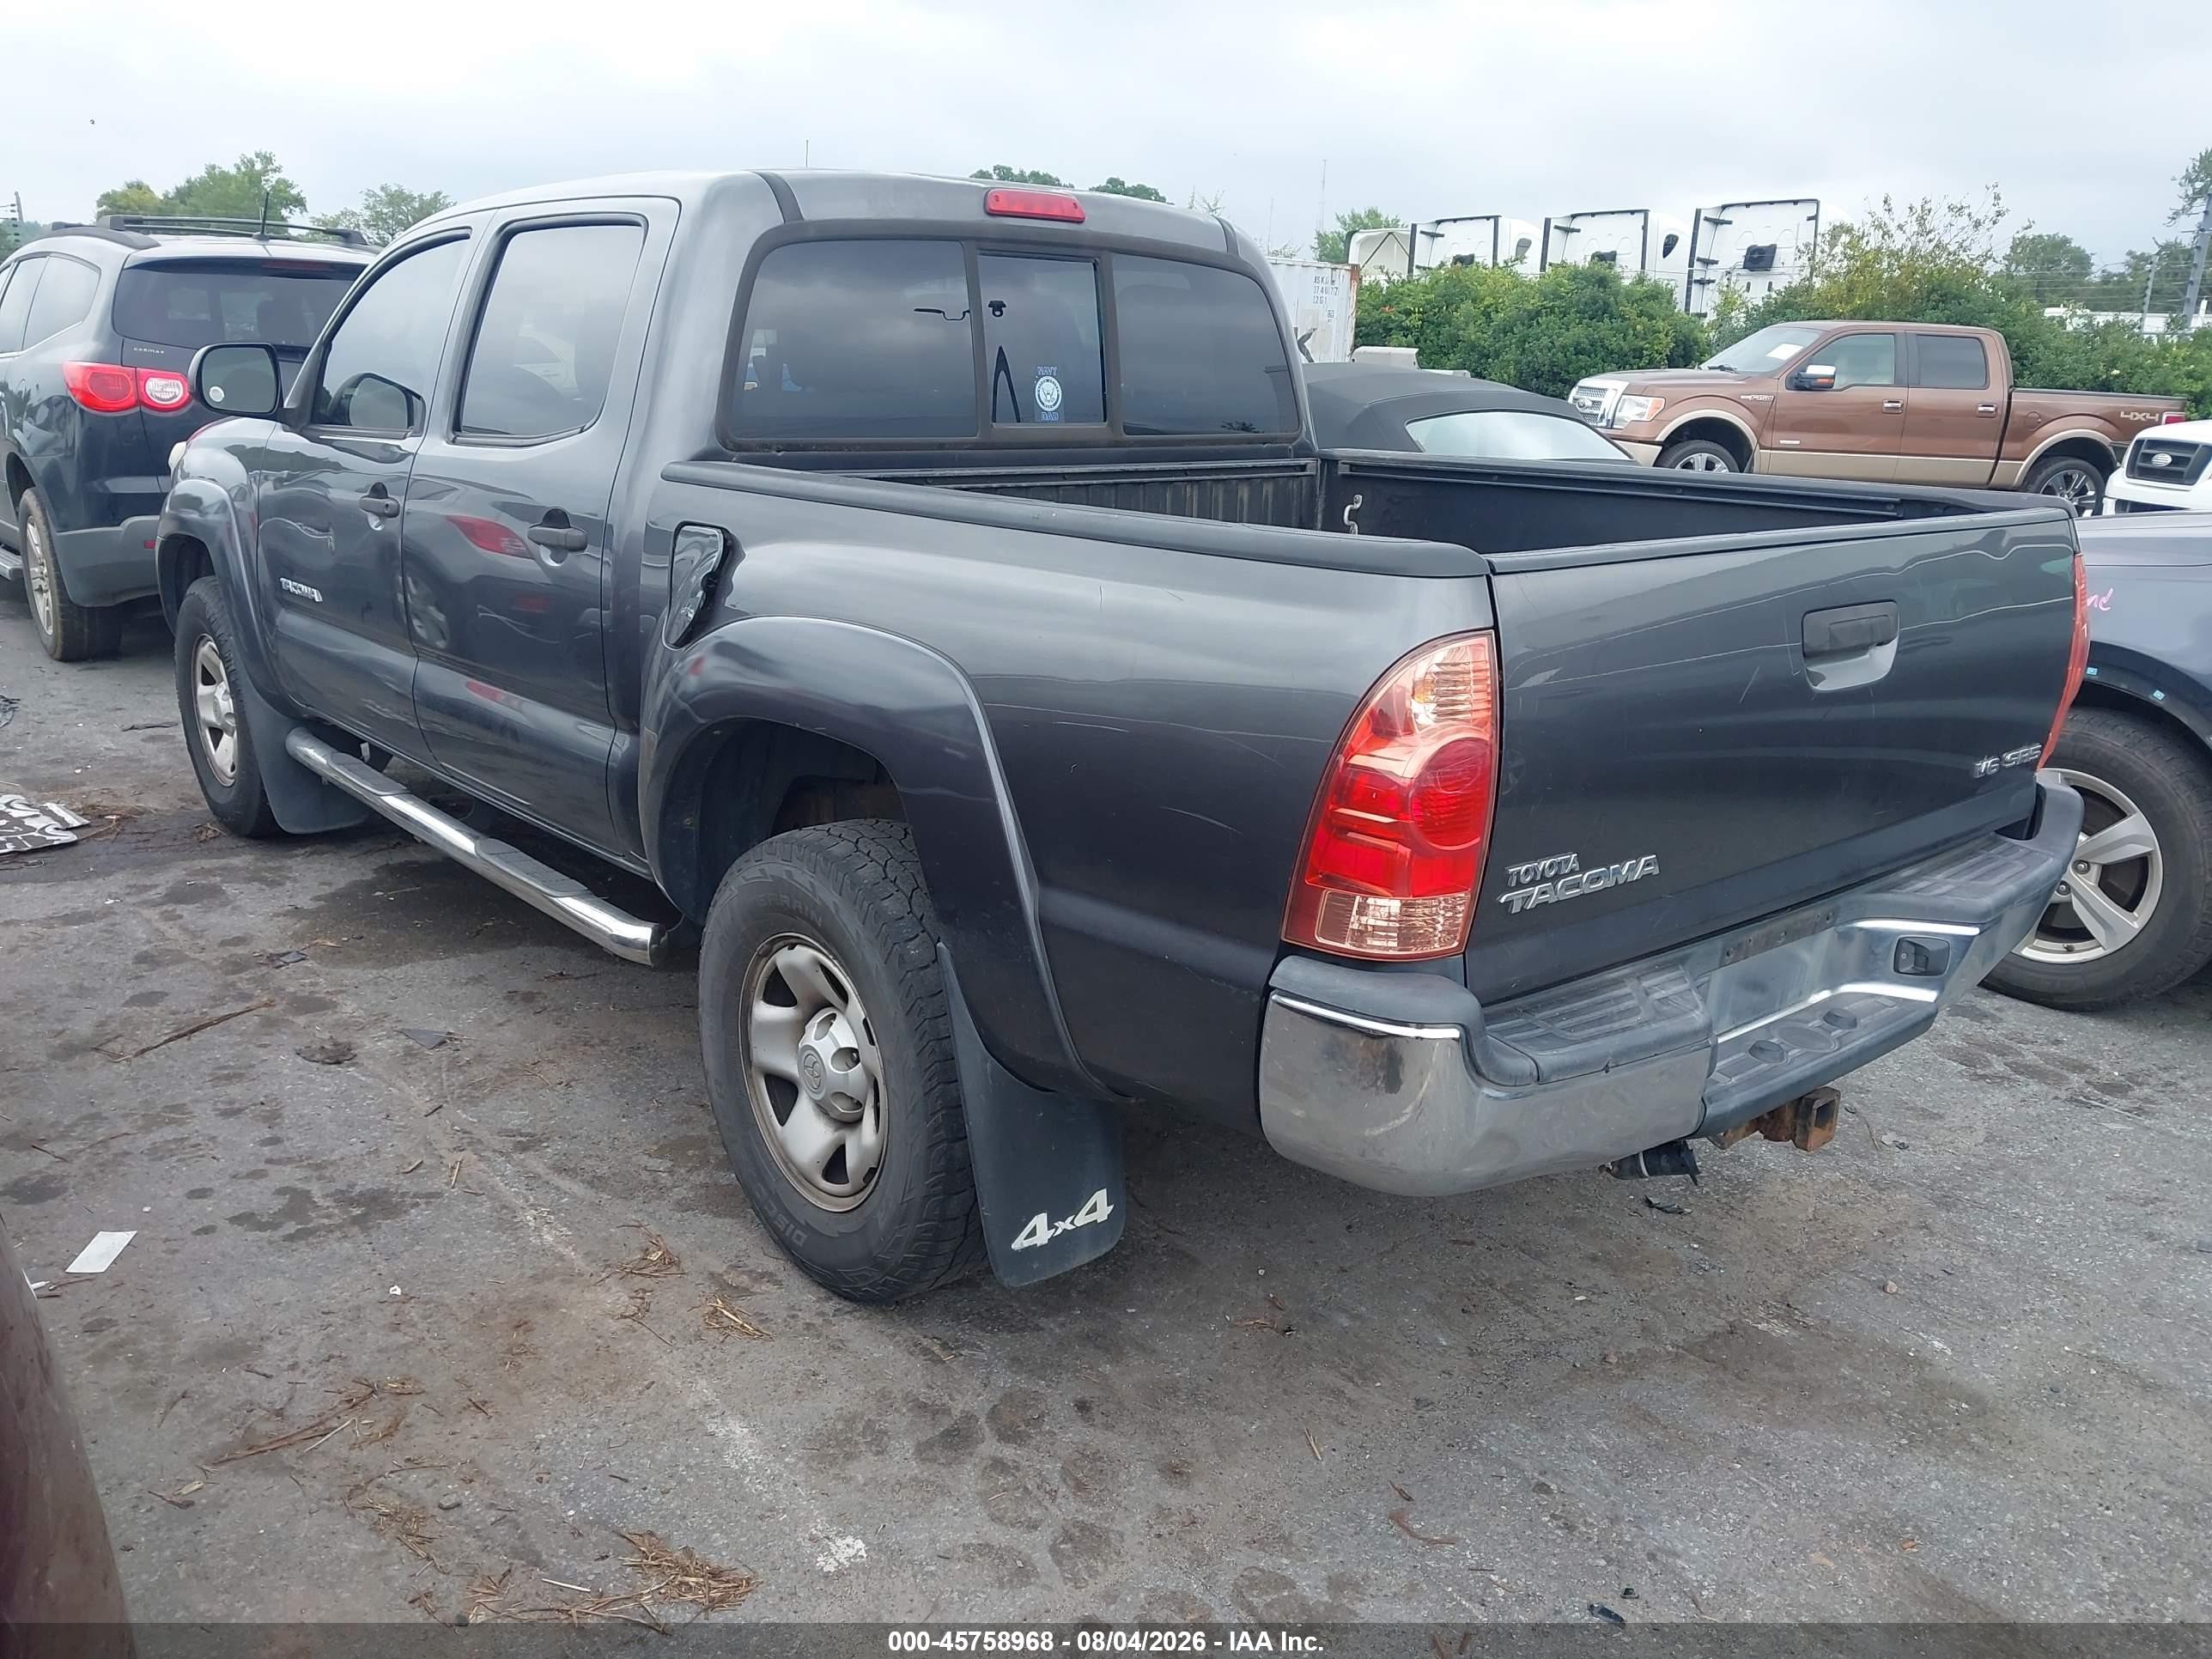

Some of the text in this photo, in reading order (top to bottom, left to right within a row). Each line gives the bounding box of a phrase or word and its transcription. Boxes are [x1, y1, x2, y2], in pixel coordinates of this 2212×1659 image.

[1497, 854, 1661, 914] TACOMA
[1505, 852, 1580, 887] TOYOTA
[1012, 1188, 1115, 1251] 4x4
